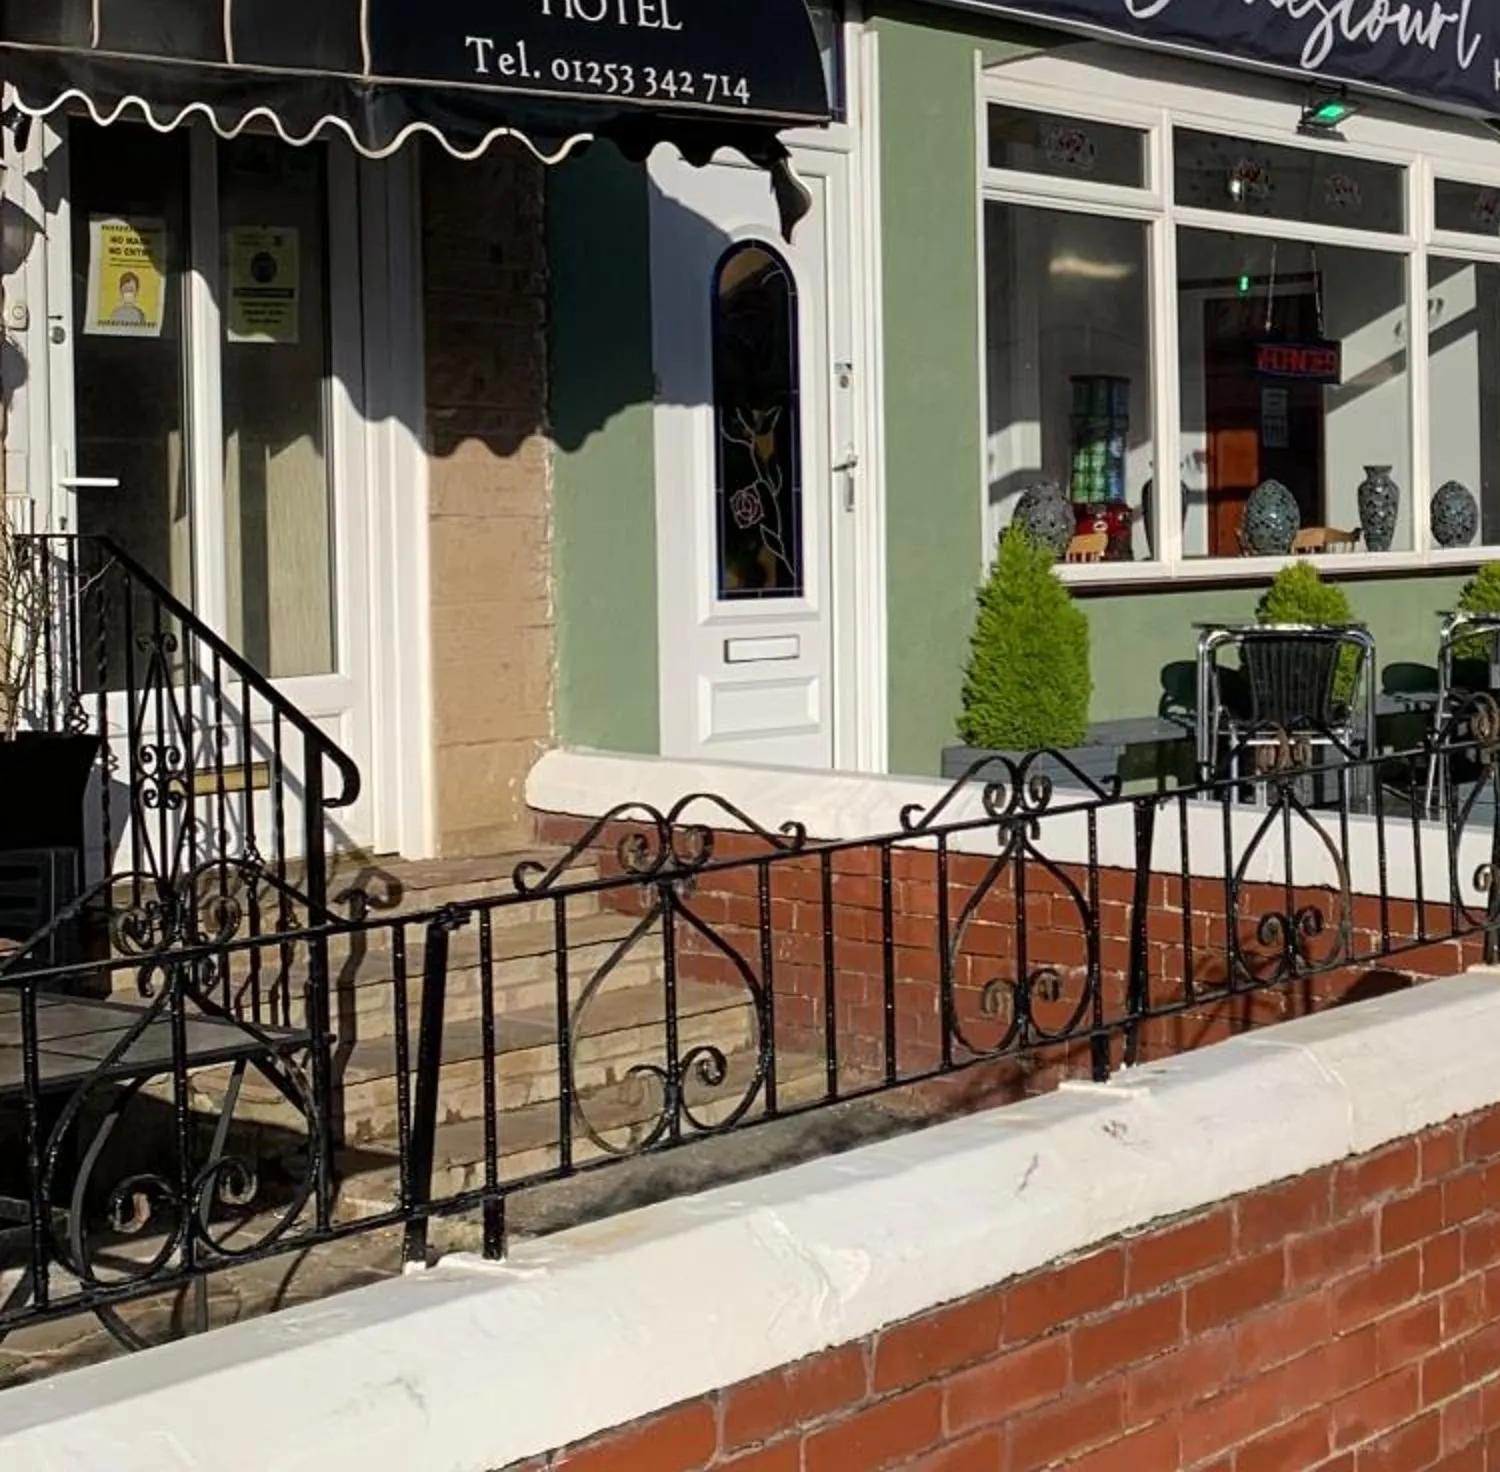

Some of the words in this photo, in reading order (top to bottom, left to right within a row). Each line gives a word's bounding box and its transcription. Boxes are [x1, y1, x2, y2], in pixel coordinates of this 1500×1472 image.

[465, 35, 542, 79] Tel.
[550, 58, 636, 95] 01253
[644, 66, 695, 99] 342
[703, 73, 751, 105] 714
